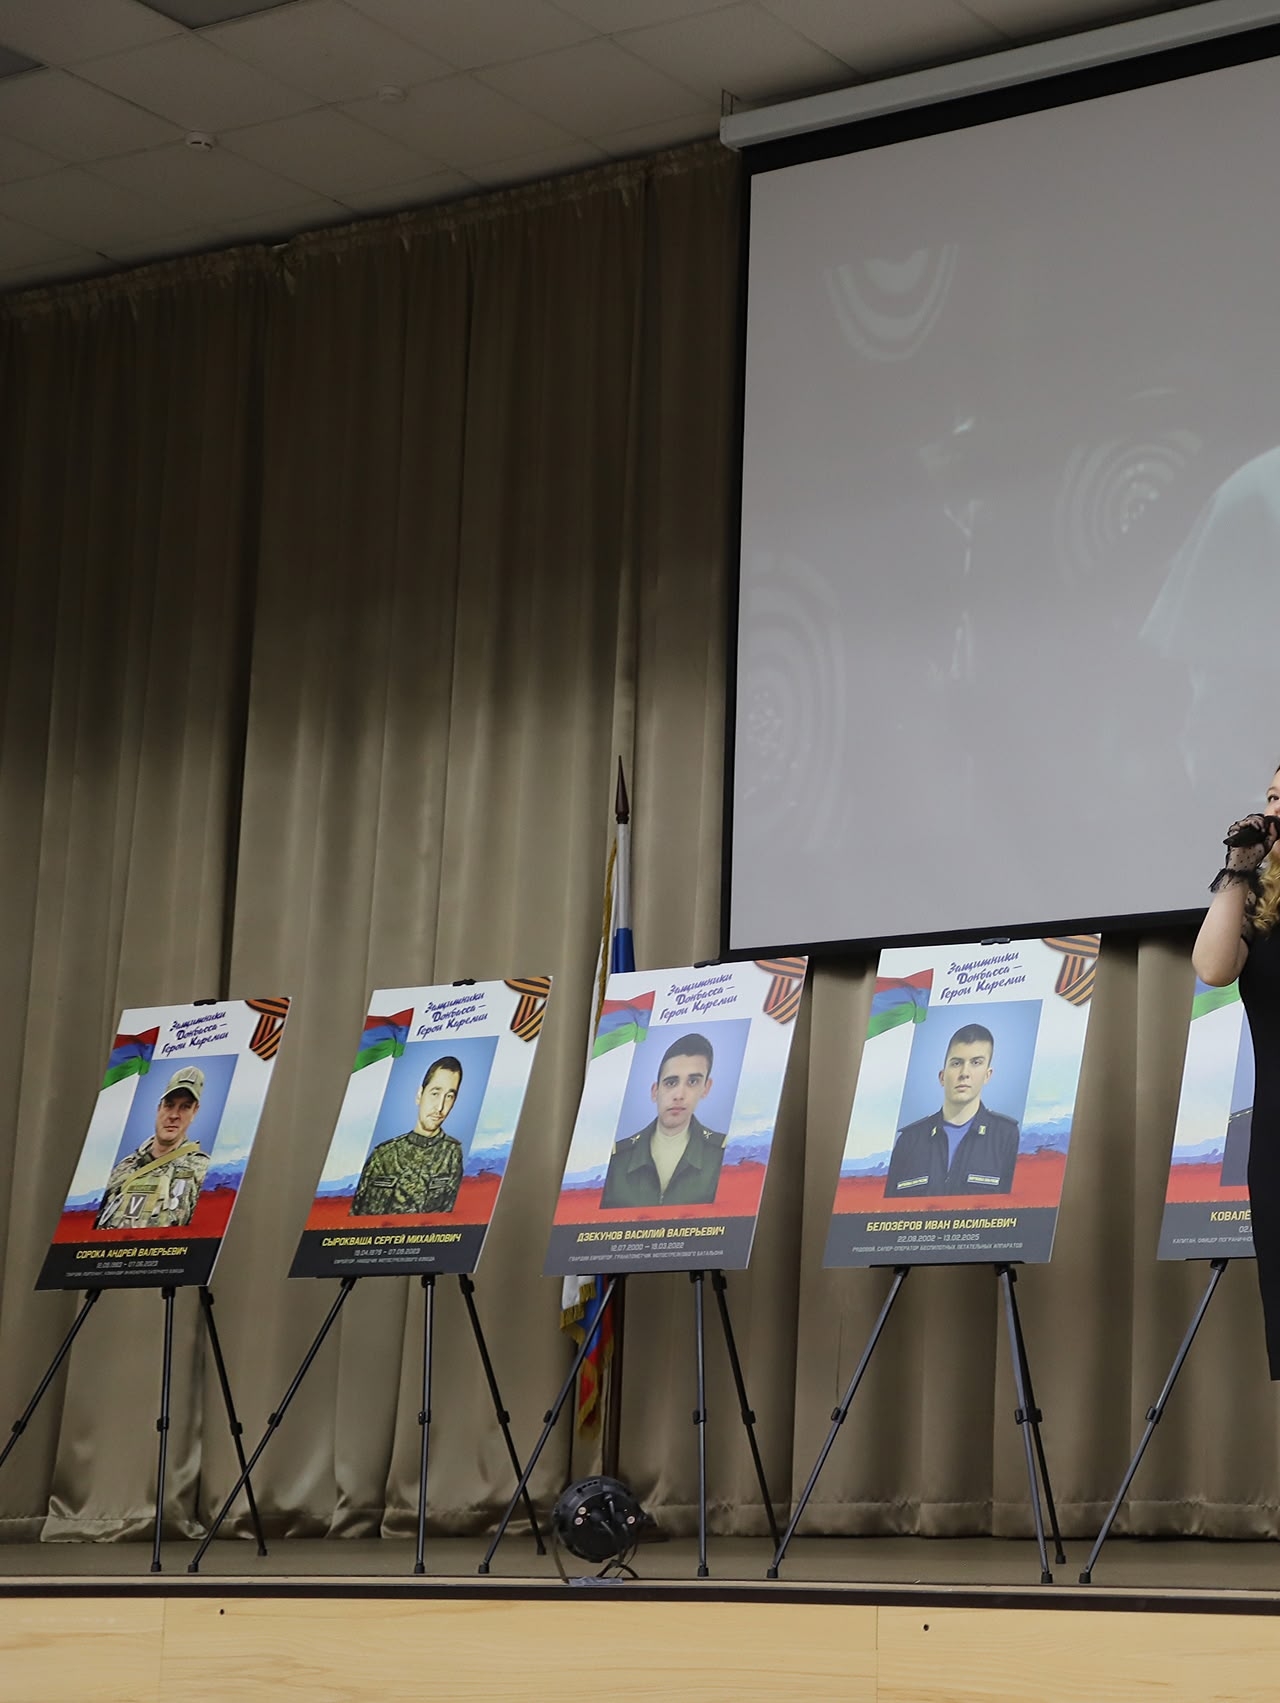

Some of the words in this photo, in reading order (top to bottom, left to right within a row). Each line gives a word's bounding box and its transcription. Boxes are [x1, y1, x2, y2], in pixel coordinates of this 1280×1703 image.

[947, 952, 1019, 975] Защитники
[957, 967, 1010, 984] Донбасса
[668, 974, 732, 996] Защитники
[940, 986, 971, 1004] Герои
[976, 975, 1026, 995] Карелии
[676, 987, 723, 1005] Донбасса
[660, 1008, 688, 1023] Герои
[692, 995, 737, 1015] Карелии
[924, 1219, 950, 1230] ИВАН
[953, 1218, 1017, 1229] ВАСИЛЬЕВИЧ
[322, 1237, 372, 1246] СЫРОКВАША
[374, 1234, 405, 1245] СЕРГЕЙ
[406, 1233, 462, 1243] МИХАЙЛОВИЧ
[577, 1231, 623, 1242] ДЗЕКУНОВ
[625, 1228, 665, 1239] ВАСИЛИЙ
[667, 1226, 725, 1238] ВАЛЕРЬЕВИЧ
[76, 1250, 105, 1259] СОРОКА
[106, 1248, 137, 1257] АНДРЕЙ
[138, 1247, 188, 1256] ВАЛЕРЬЕВИЧ
